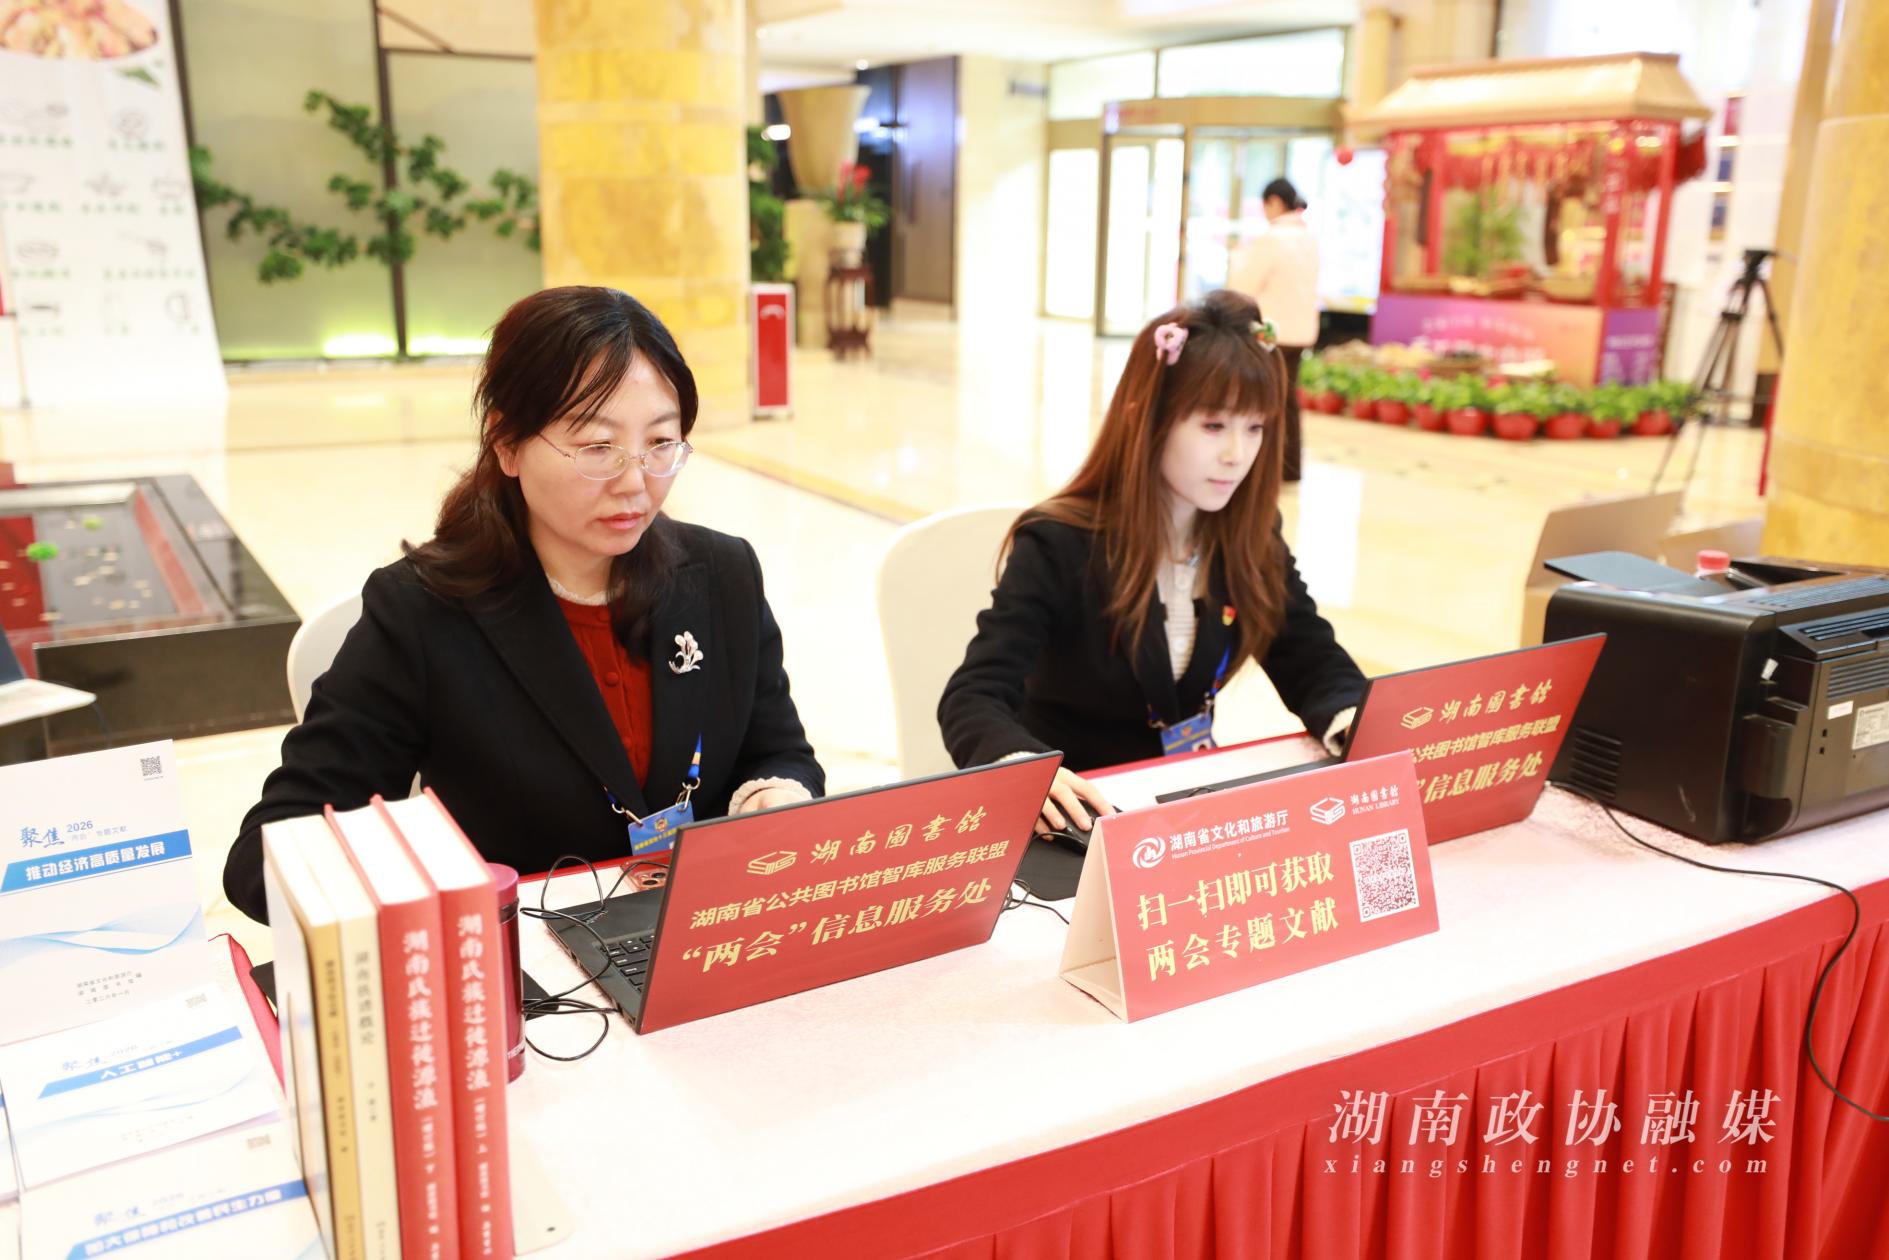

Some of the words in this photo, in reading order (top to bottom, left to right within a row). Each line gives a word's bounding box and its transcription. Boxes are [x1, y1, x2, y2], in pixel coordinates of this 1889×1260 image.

[20, 826, 64, 847] 聚焦
[66, 820, 94, 833] 2026
[1169, 809, 1289, 852] 湖南省文化和旅游厅
[25, 841, 166, 880] 推动经济高质量发展
[690, 840, 1009, 930] 湖南省公共图书馆智库服务联盟
[1137, 851, 1335, 931] 扫一扫即可获取
[682, 877, 993, 973] “两会”信息服务处
[1146, 897, 1339, 982] 两会专题文献
